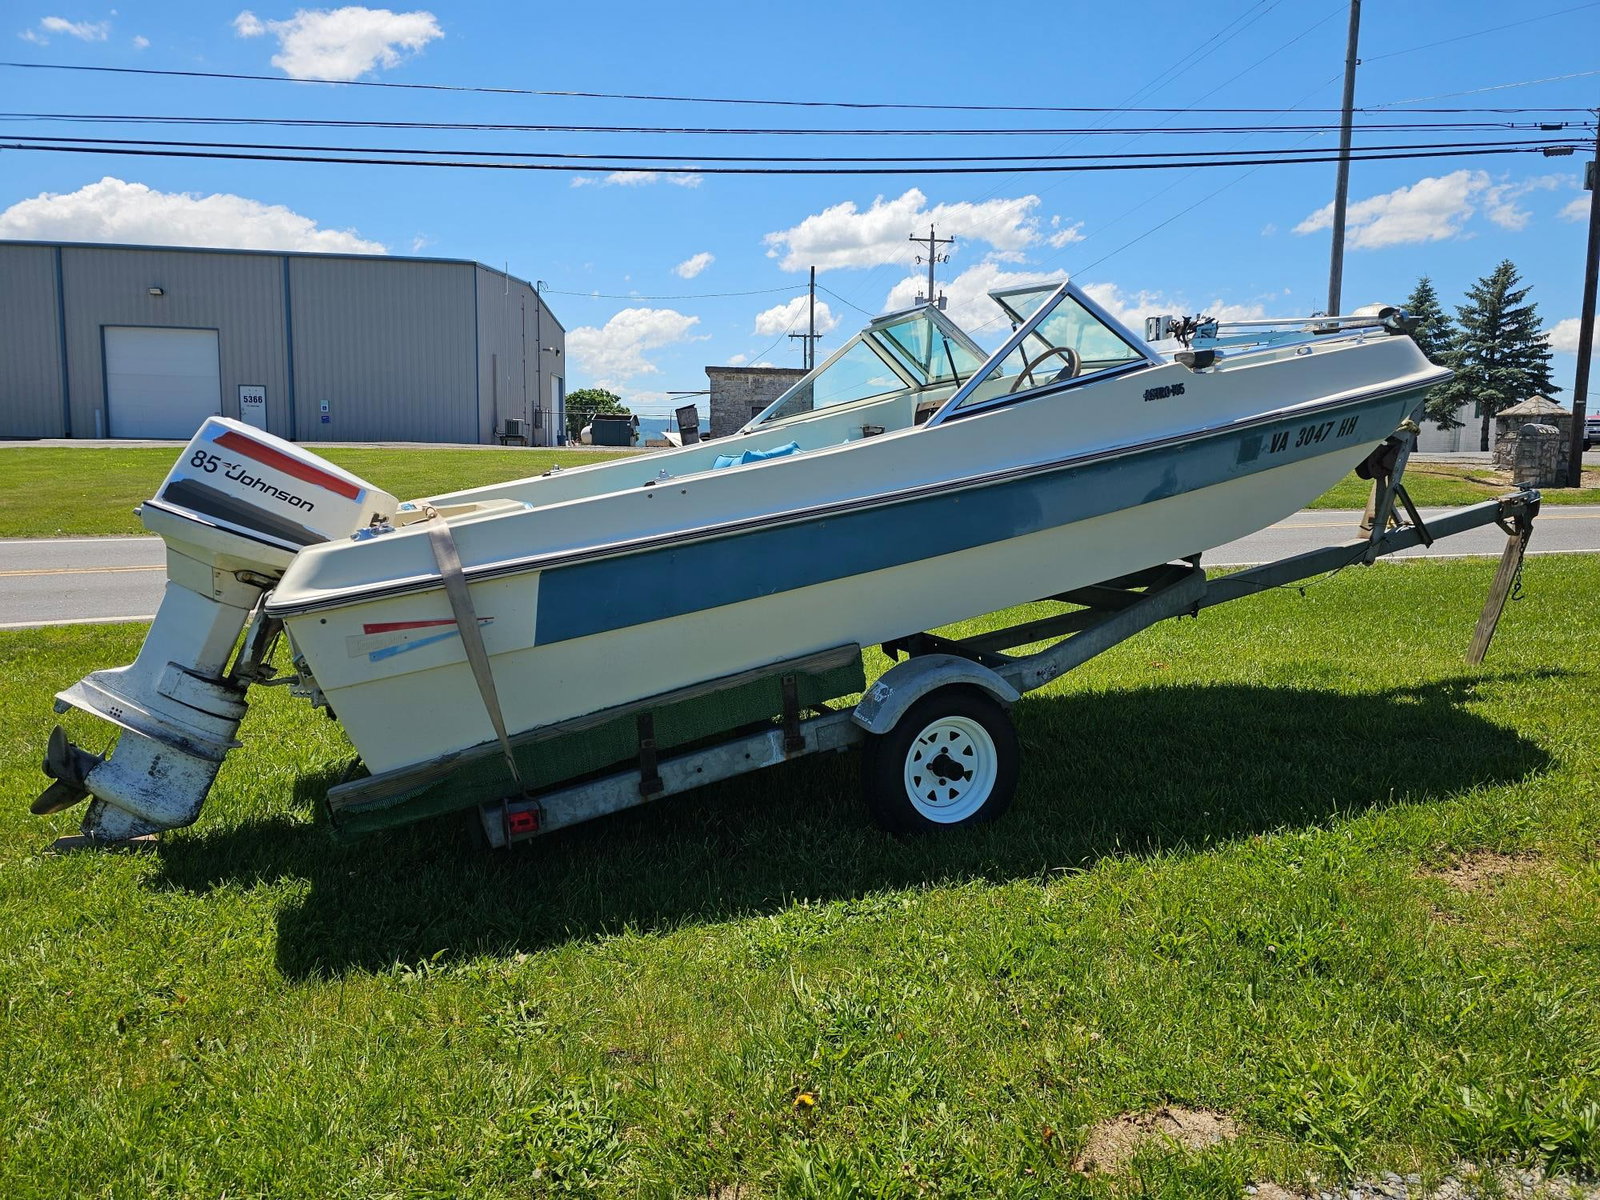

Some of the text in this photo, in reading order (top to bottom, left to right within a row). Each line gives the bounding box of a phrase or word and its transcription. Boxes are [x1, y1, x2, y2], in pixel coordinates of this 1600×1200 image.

[243, 395, 263, 404] 5366
[1269, 415, 1359, 454] VA 3047 HH
[190, 449, 315, 512] 85 Johnson
